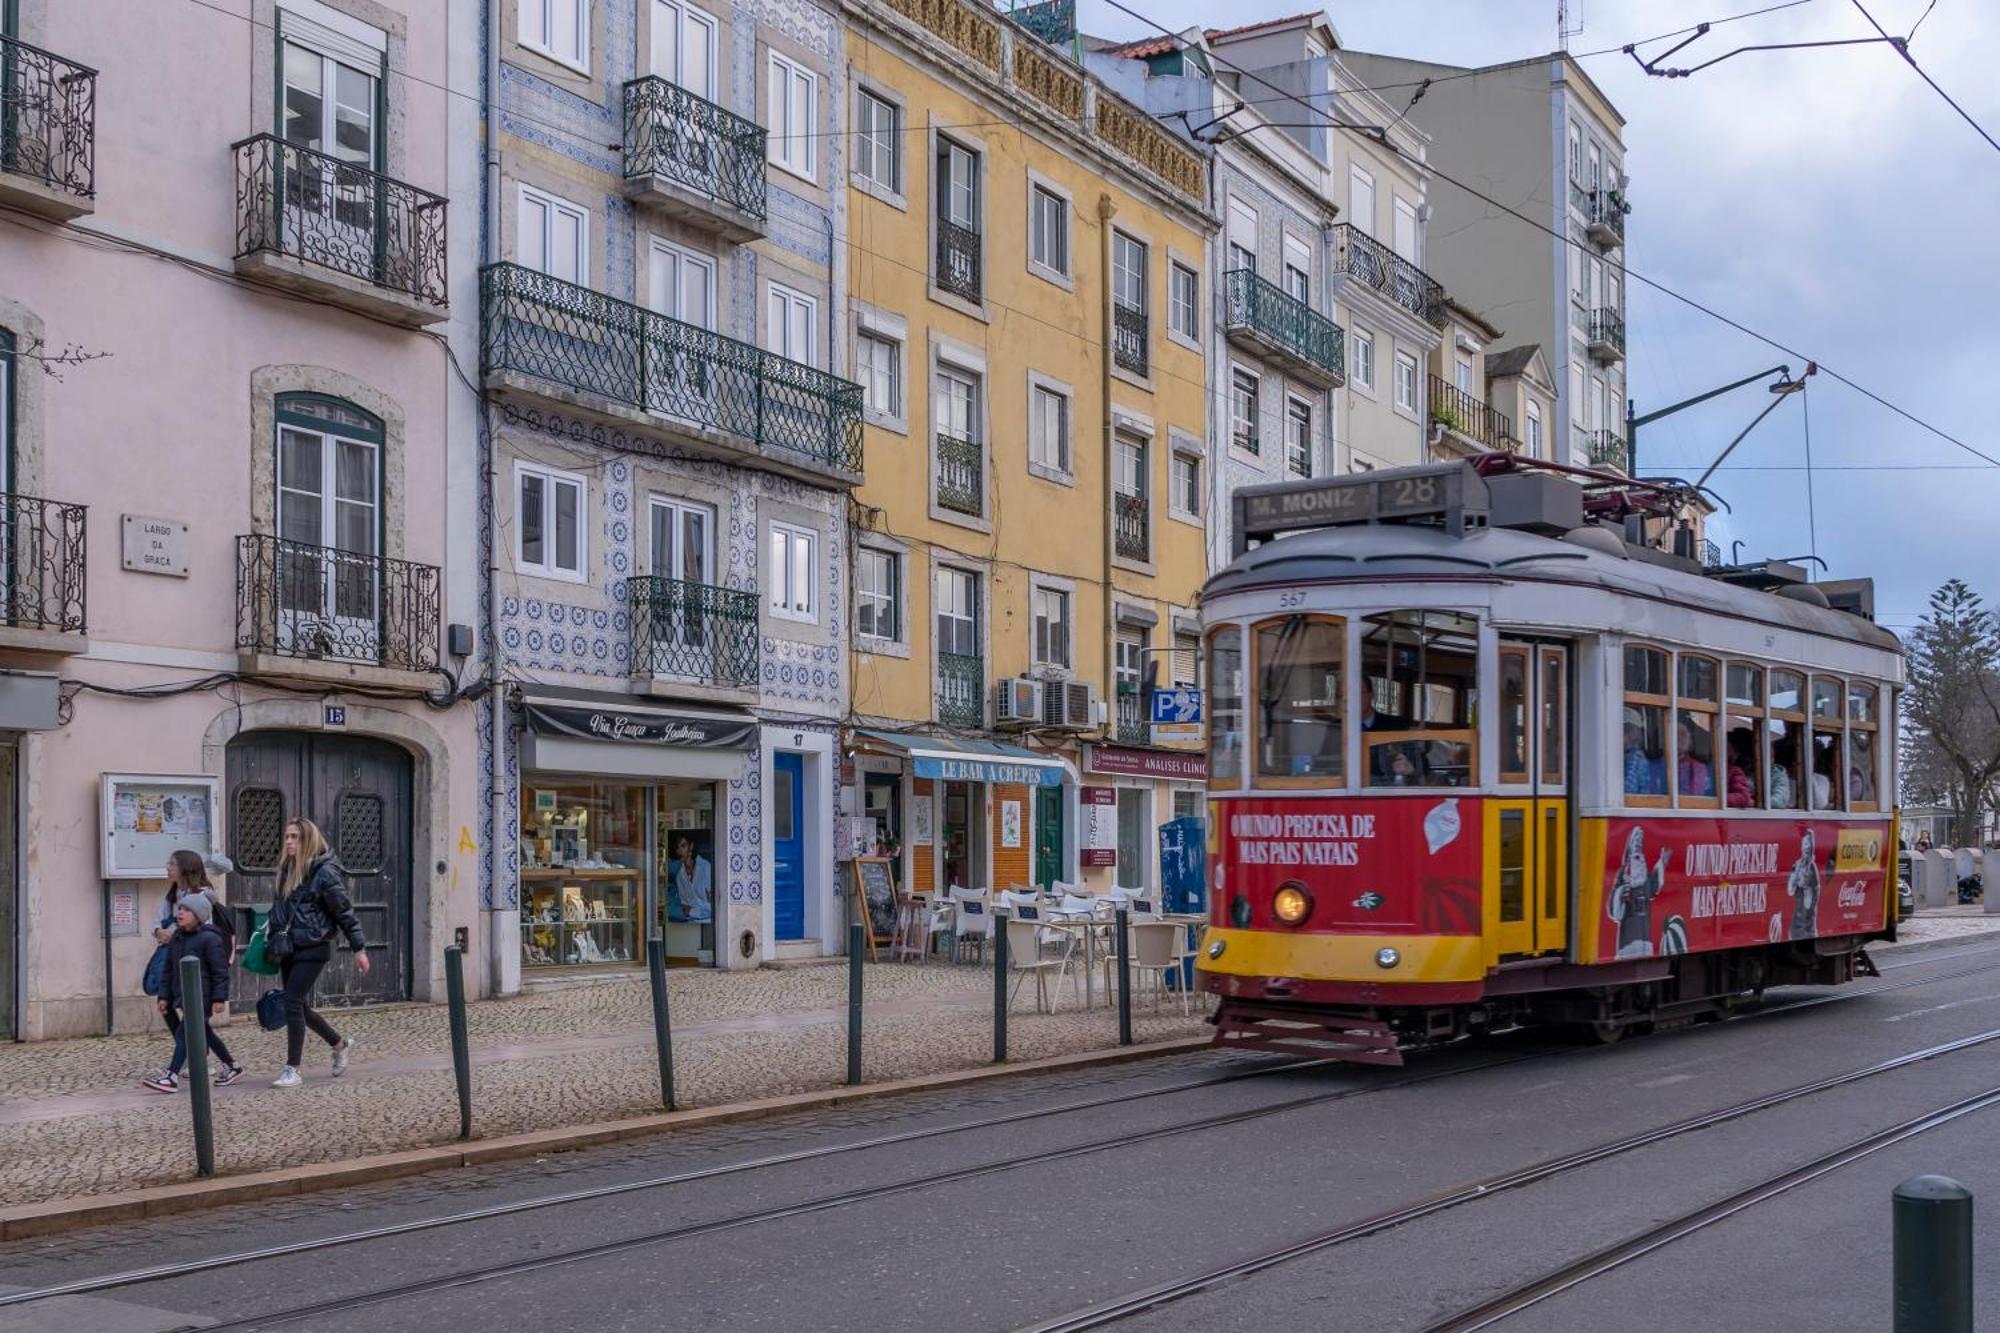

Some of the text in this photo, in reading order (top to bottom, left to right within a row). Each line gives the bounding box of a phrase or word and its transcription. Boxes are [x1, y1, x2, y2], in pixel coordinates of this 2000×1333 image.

[1253, 487, 1355, 515] M. MONIZ
[1395, 478, 1435, 505] 28
[144, 524, 171, 536] LARGO
[152, 540, 164, 550] DA
[330, 708, 343, 722] 15
[1158, 694, 1174, 718] P
[590, 714, 611, 733] Via
[793, 734, 804, 746] 17
[942, 760, 956, 778] LE
[960, 761, 984, 780] BAR
[1238, 815, 1283, 837] MUNDO
[1284, 815, 1347, 838] PRECISA
[1351, 815, 1375, 838] DE
[1240, 842, 1359, 865] MAIS PAIS NATAIS
[1685, 843, 1779, 877] O MUNDO PRECISA DE
[1691, 886, 1715, 918] MAIS
[1737, 883, 1768, 915] NATAIS
